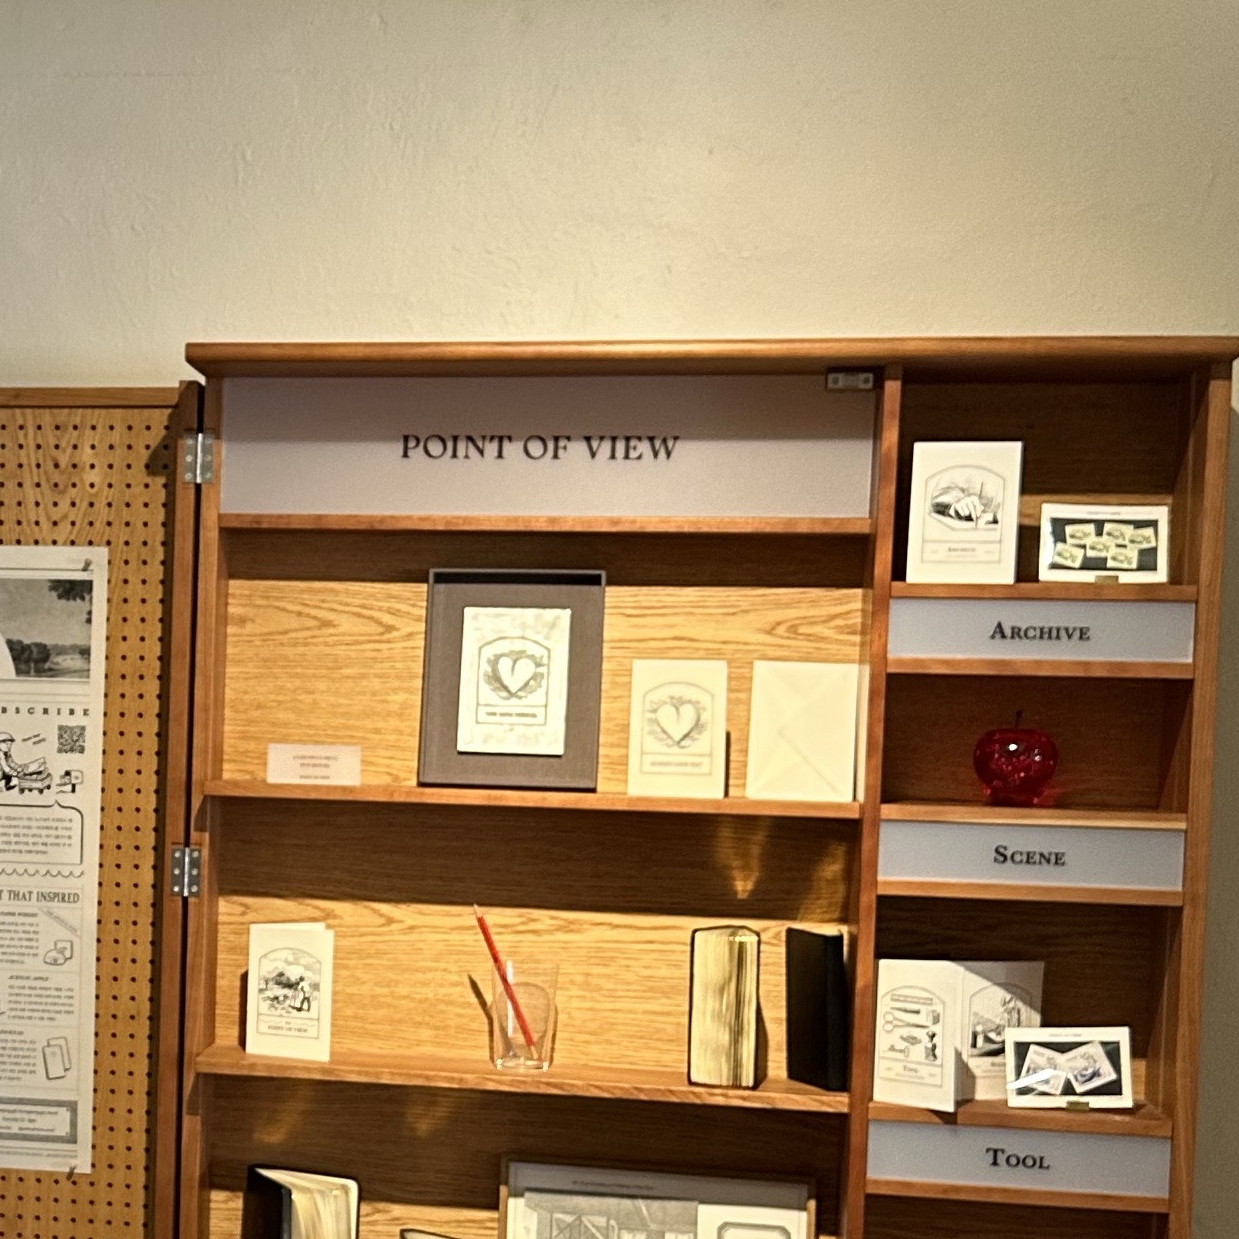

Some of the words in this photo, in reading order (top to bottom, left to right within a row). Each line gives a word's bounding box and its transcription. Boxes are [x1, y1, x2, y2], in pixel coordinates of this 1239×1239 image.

[401, 434, 513, 460] POINT
[522, 434, 571, 460] OF
[582, 435, 681, 461] VIEW
[989, 621, 1091, 642] ARCHIVE
[993, 845, 1066, 867] SCENE
[7, 889, 34, 902] THAT
[36, 891, 80, 903] INSPIRED
[986, 1147, 1050, 1171] TOOL
